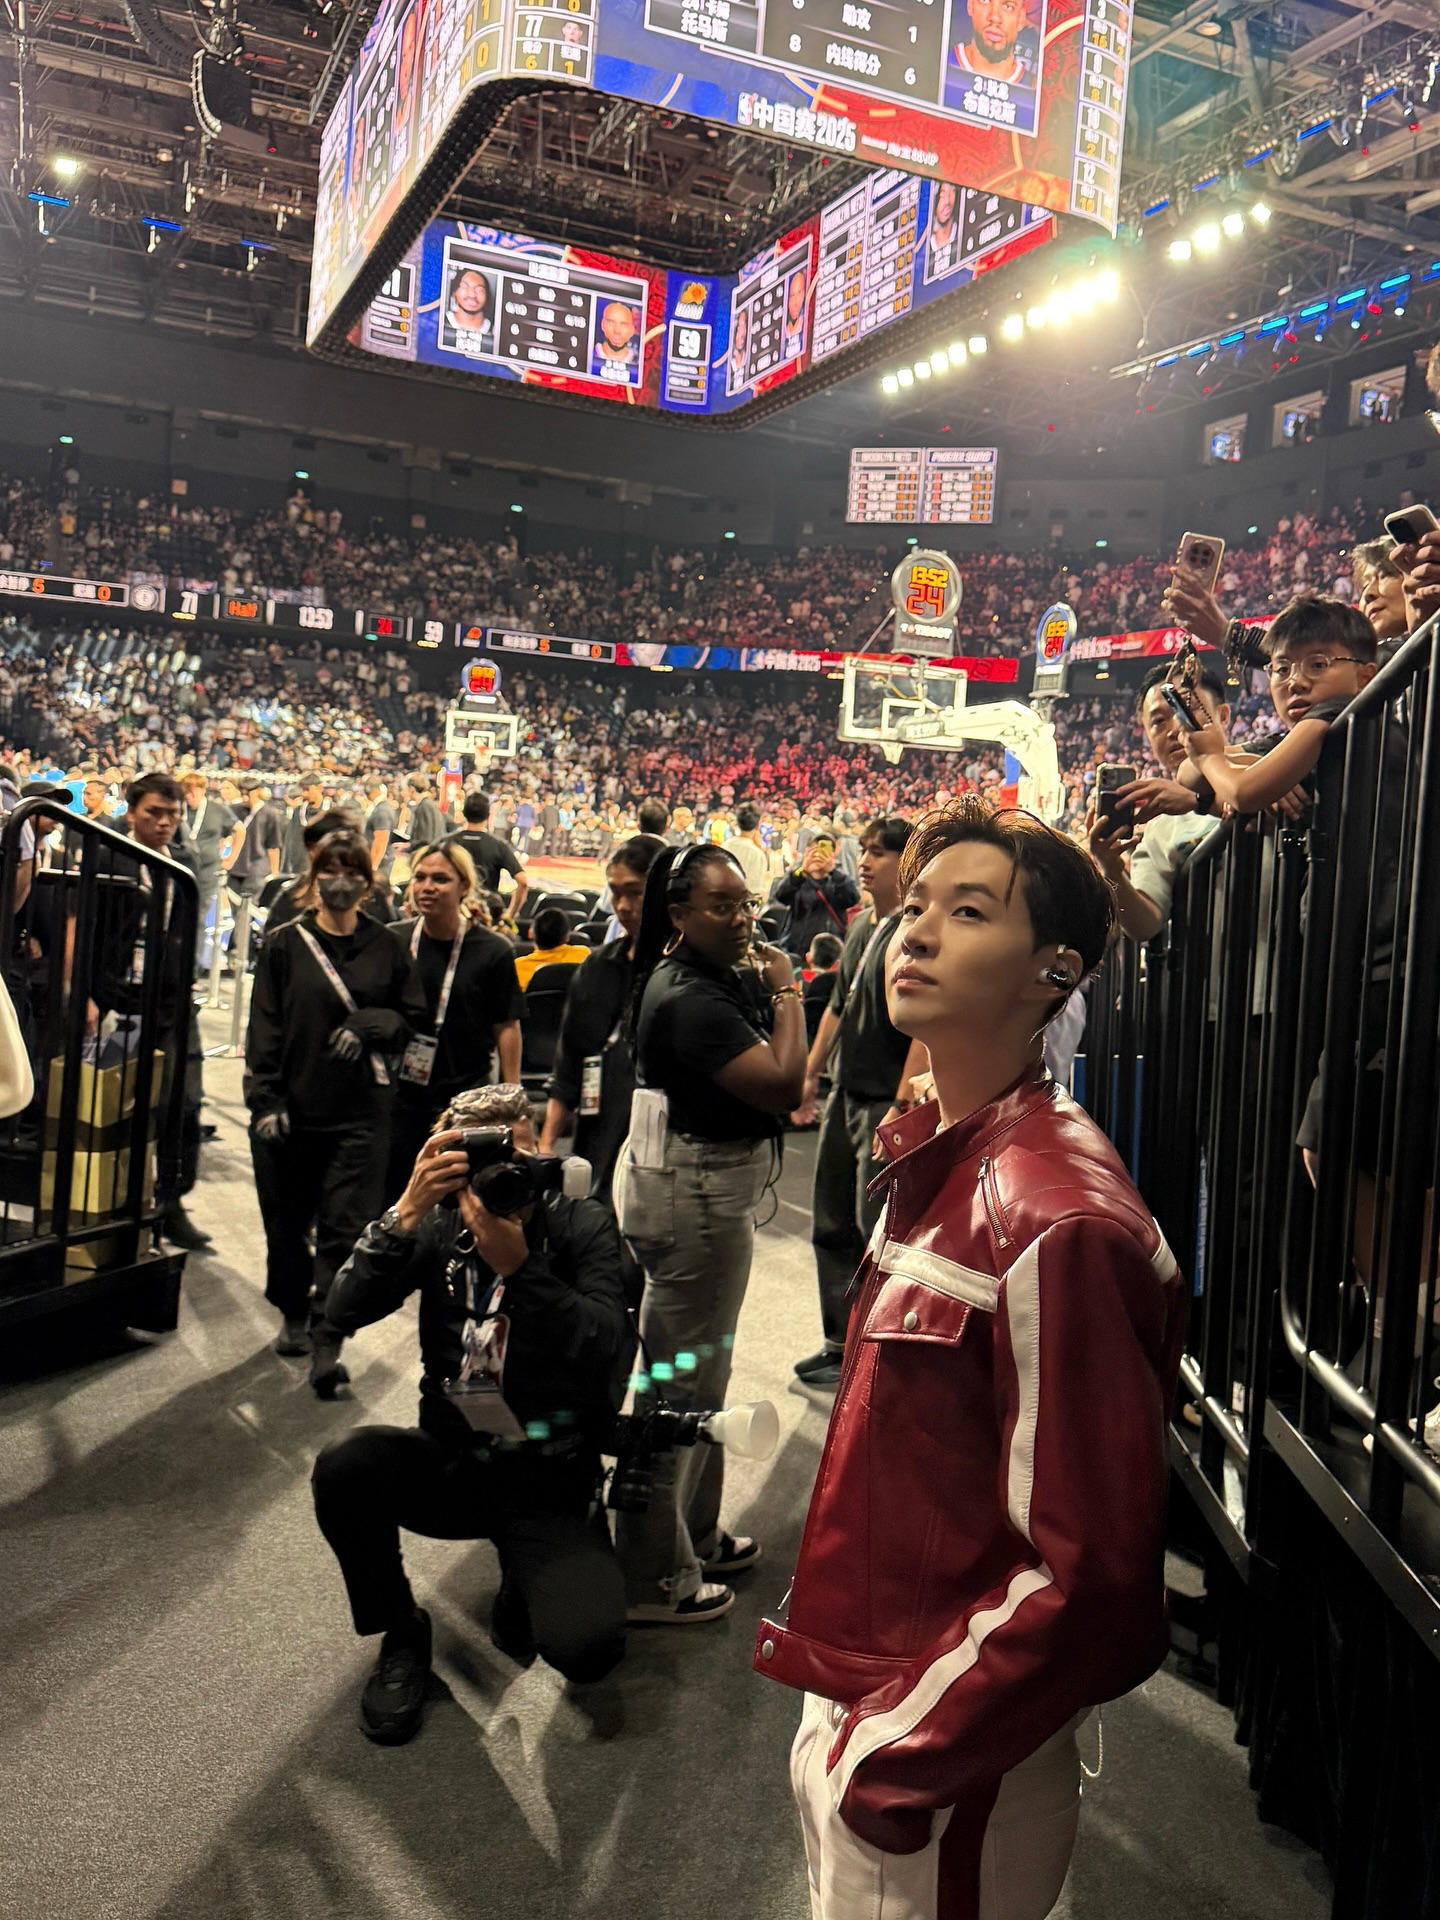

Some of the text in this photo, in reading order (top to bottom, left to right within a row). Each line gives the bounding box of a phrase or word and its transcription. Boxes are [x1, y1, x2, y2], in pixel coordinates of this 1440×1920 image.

[525, 15, 543, 37] 77
[681, 10, 728, 42] 托马斯
[908, 26, 918, 43] 1
[477, 42, 489, 67] 0
[525, 55, 574, 75] 6 1
[789, 34, 916, 85] 8 内线得分 6
[753, 97, 857, 151] 中国赛2025
[679, 329, 701, 358] 59
[98, 585, 111, 601] 0
[906, 583, 944, 617] 24
[591, 644, 602, 659] 0
[1045, 636, 1064, 657] 24
